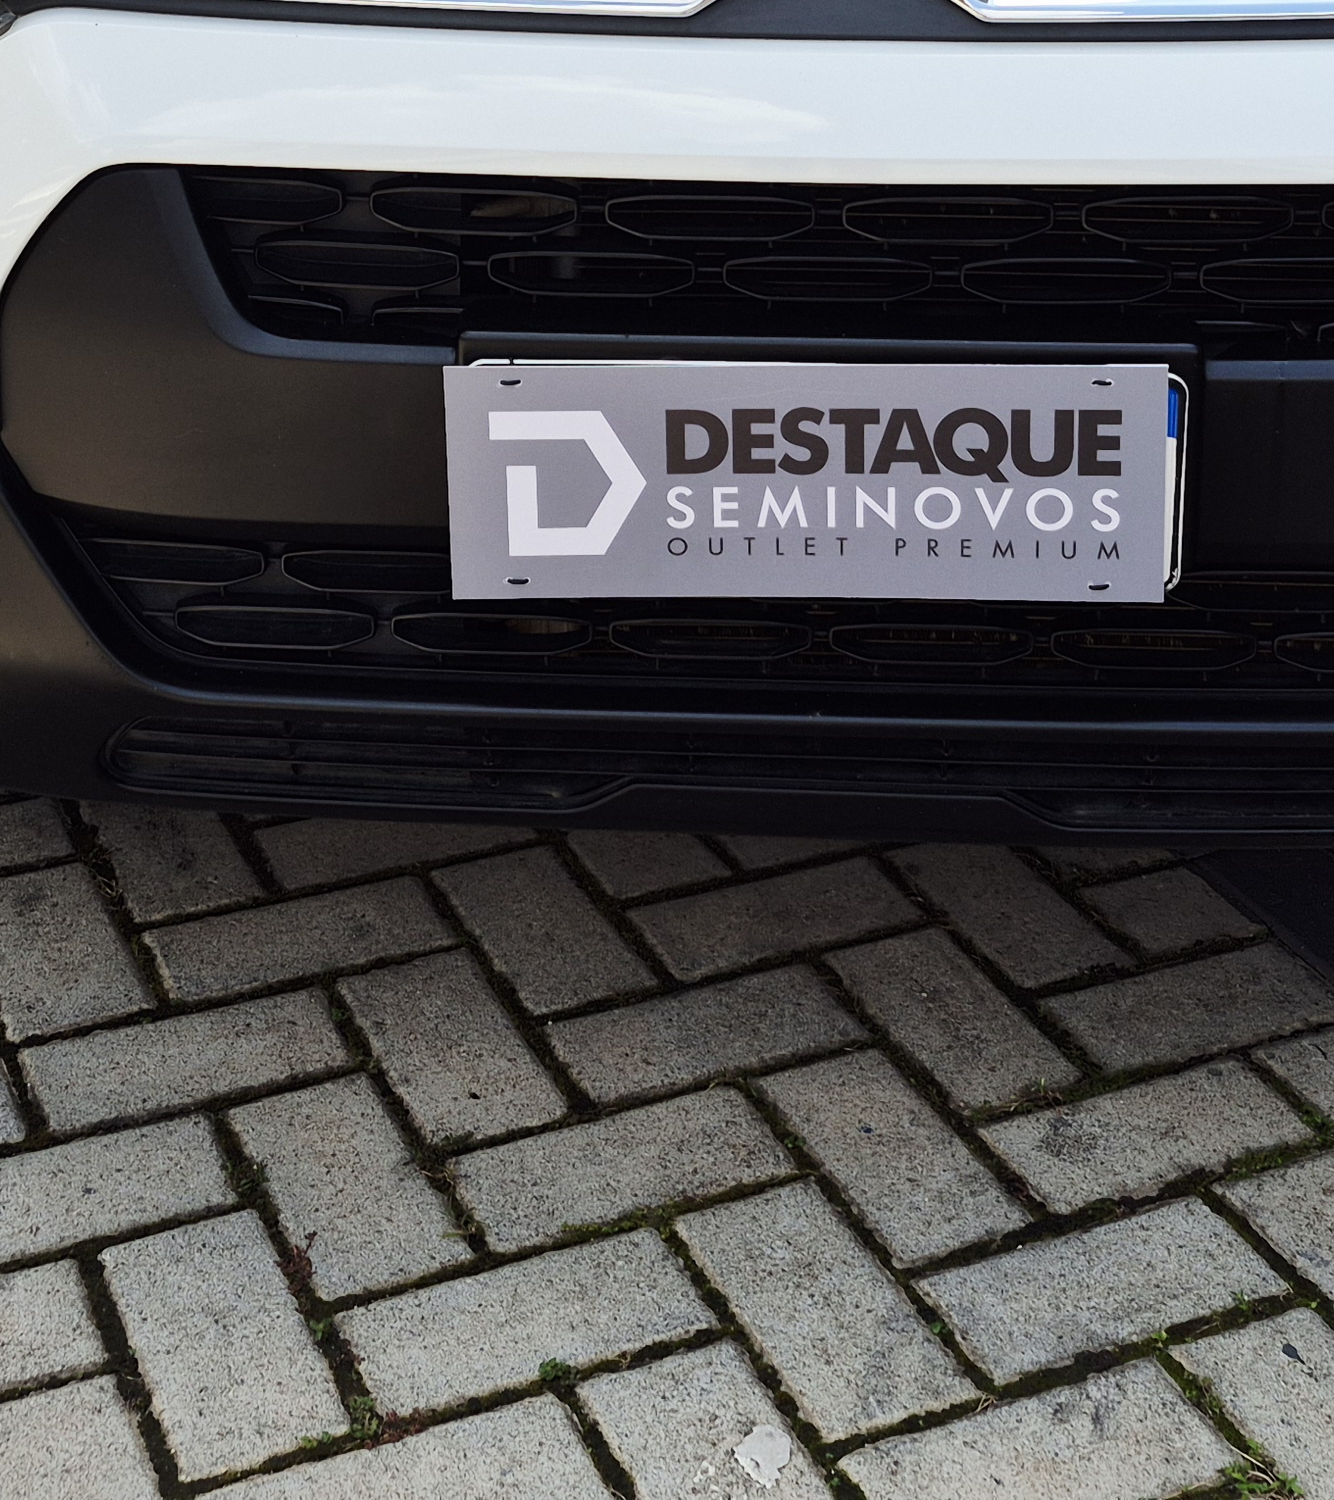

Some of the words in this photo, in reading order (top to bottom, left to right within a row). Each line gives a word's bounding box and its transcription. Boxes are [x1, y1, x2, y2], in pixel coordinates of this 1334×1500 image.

[665, 406, 1121, 483] DESTAQUE
[666, 485, 1121, 532] SEMINOVOS
[667, 536, 849, 556] OUTLET
[895, 537, 1120, 560] PREMIUM
